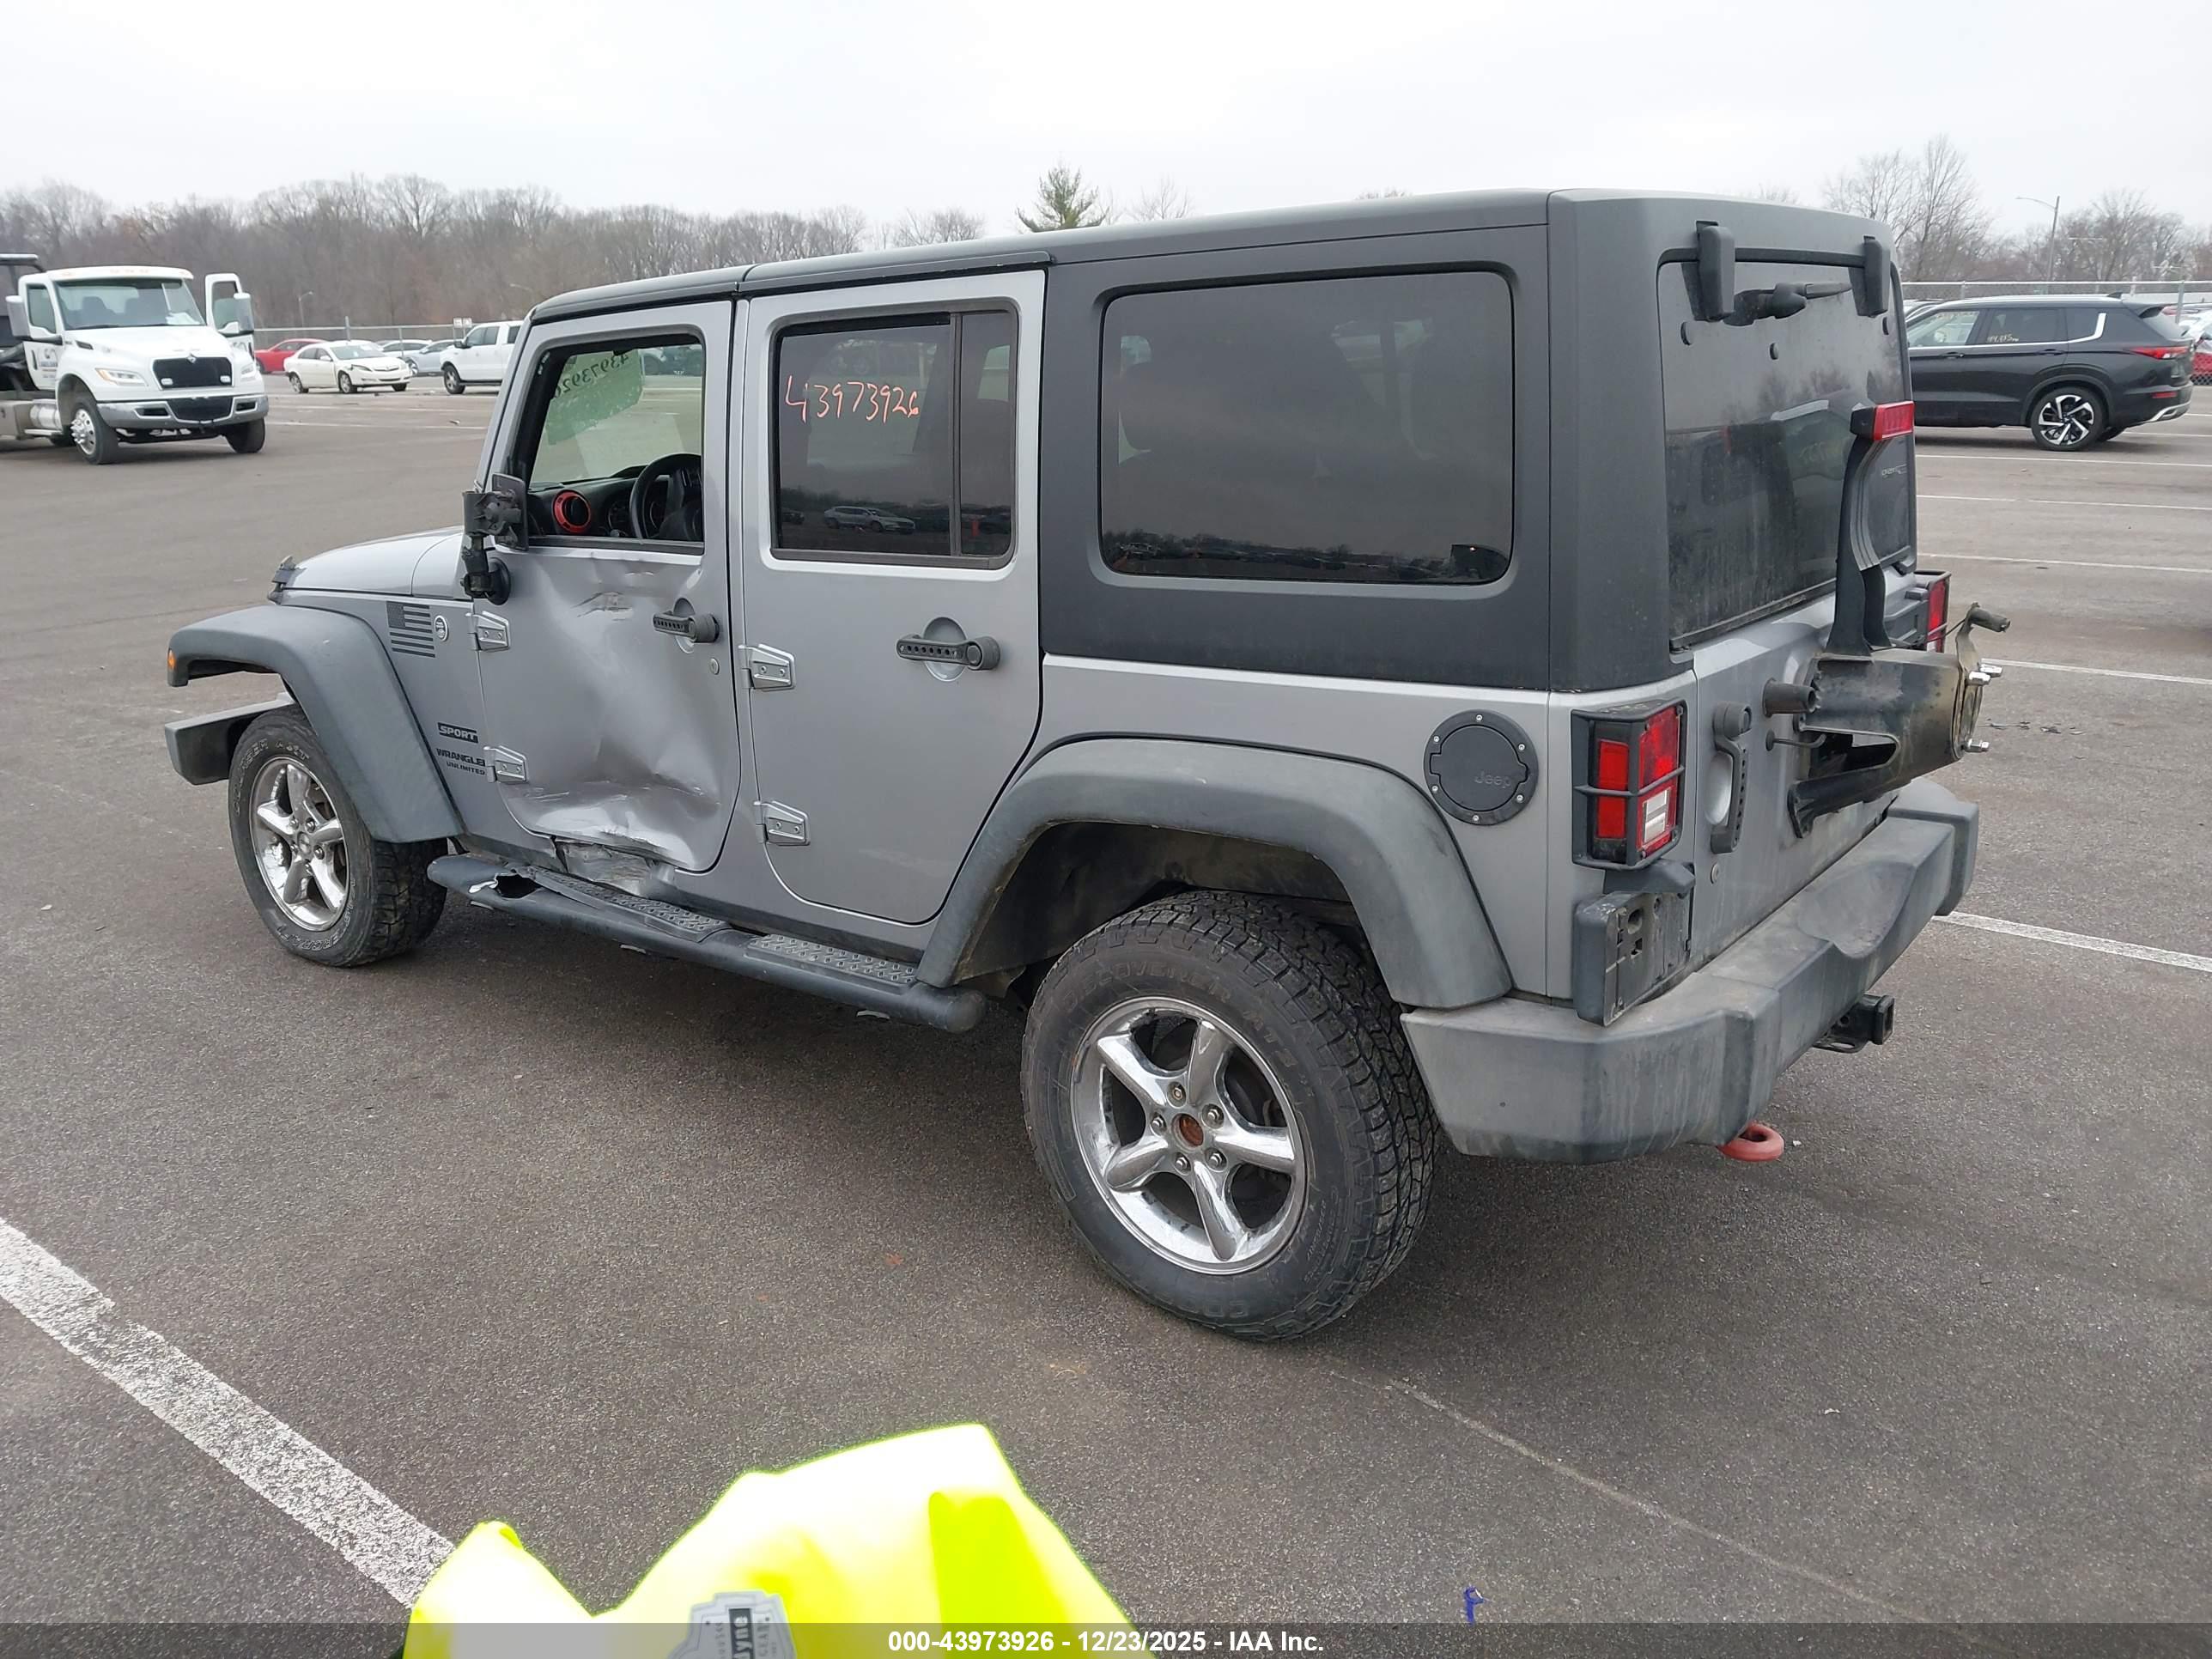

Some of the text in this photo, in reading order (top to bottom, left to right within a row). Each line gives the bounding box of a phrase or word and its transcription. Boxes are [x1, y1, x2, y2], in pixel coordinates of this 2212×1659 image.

[785, 375, 920, 423] 43973926
[439, 724, 477, 742] SPORT
[447, 761, 486, 775] UNLIMITED
[1474, 771, 1511, 789] Jeep
